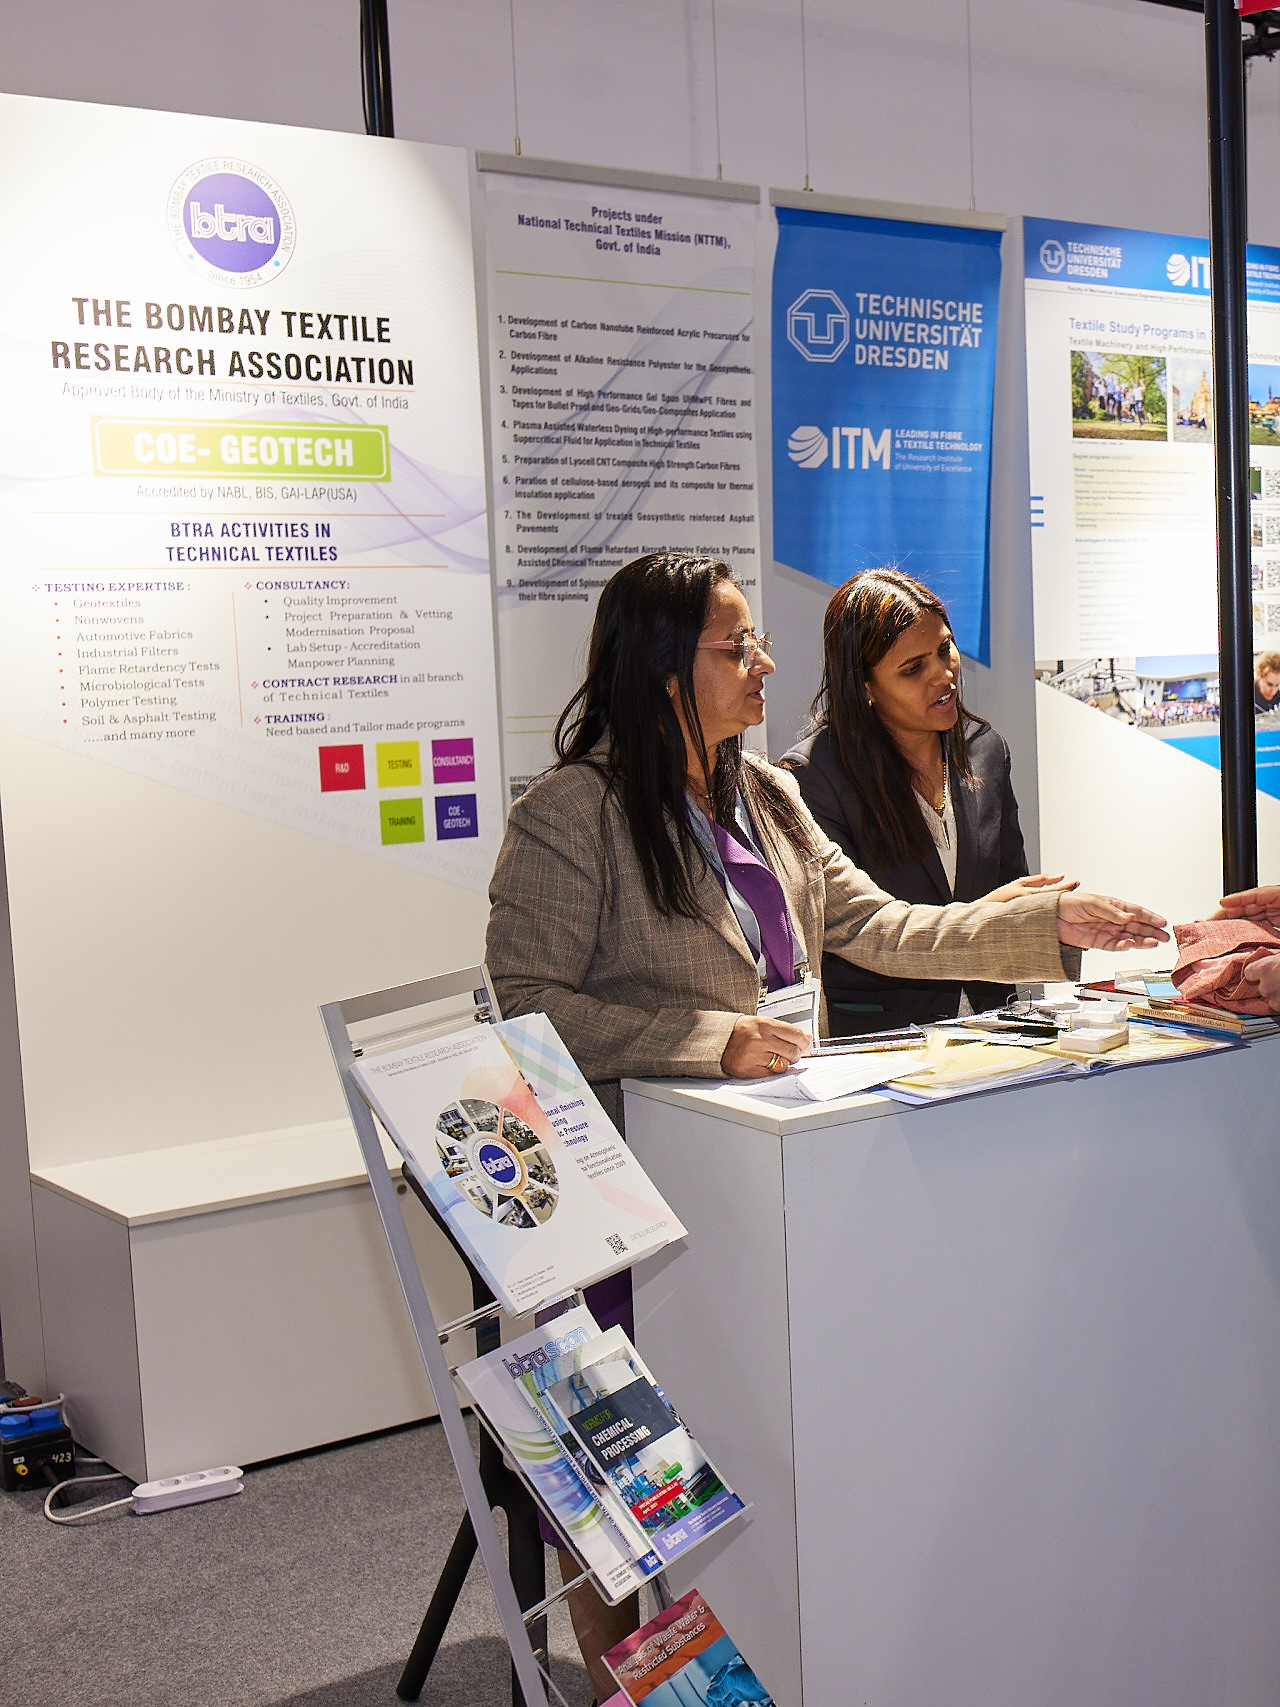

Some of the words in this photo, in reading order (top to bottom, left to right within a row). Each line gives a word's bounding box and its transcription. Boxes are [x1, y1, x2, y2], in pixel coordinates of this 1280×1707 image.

[189, 201, 275, 245] btra
[591, 206, 632, 222] Projects
[634, 213, 662, 225] under
[517, 213, 561, 230] National
[564, 219, 613, 235] Technical
[615, 224, 652, 240] Textiles
[654, 229, 691, 243] Mission
[694, 233, 731, 250] (NTTM),
[595, 238, 621, 252] Govt.
[623, 241, 634, 254] of
[636, 242, 661, 256] India
[1067, 241, 1122, 258] TECHNISCHE
[1067, 263, 1109, 279] DRESDEN
[1191, 255, 1211, 289] IT
[855, 292, 983, 324] TECHNISCHE
[72, 297, 132, 328] THE
[145, 302, 270, 336] BOMBAY
[281, 311, 391, 343] TEXTILE
[509, 329, 537, 339] Carbon
[538, 331, 558, 341] Fibre
[855, 318, 983, 348] UNIVERSITÄT
[1069, 317, 1105, 332] Textile
[1109, 321, 1141, 338] Study
[1143, 324, 1194, 340] Programs
[1196, 330, 1206, 341] in
[1069, 337, 1094, 347] Textile
[1095, 339, 1133, 351] Machinery
[1135, 342, 1149, 351] and
[1150, 343, 1167, 354] High
[51, 341, 216, 376] RESEARCH
[228, 350, 414, 385] ASSOCIATION
[854, 343, 949, 371] DRESDEN
[510, 364, 558, 375] Applications
[62, 382, 126, 402] Approved
[131, 384, 164, 403] Body
[168, 385, 182, 400] of
[184, 386, 205, 401] the
[208, 387, 259, 407] Ministry
[264, 390, 277, 405] of
[279, 391, 329, 408] Textiles,
[331, 393, 363, 409] Govt.
[366, 394, 379, 409] of
[381, 395, 409, 410] India
[220, 434, 355, 468] GEOTECH
[832, 426, 892, 470] ITM
[895, 429, 929, 439] LEADING
[930, 430, 939, 440] IN
[940, 431, 963, 441] FIBRE
[903, 440, 935, 450] TEXTILE
[936, 442, 983, 452] TECHNOLOGY
[136, 484, 198, 499] Accredited
[200, 486, 214, 502] by
[217, 486, 253, 501] NABL,
[255, 487, 279, 502] BIS,
[170, 522, 214, 538] BTRA
[220, 522, 311, 539] ACTIVITIES
[315, 522, 332, 539] IN
[516, 523, 559, 533] Pavements
[166, 546, 260, 562] TECHNICAL
[265, 545, 338, 562] TEXTILES
[44, 582, 105, 593] TESTING
[108, 581, 185, 592] EXPERTISE
[256, 580, 350, 591] CONSULTANCY:
[73, 598, 141, 609] Geotextiles
[283, 595, 324, 607] Quality
[326, 595, 397, 607] Improvement
[74, 615, 144, 625] Nonwovens
[284, 612, 323, 624] Project
[329, 610, 393, 622] Preparation
[399, 610, 409, 620] &
[414, 609, 453, 621] Vetting
[76, 632, 146, 642] Automotive
[149, 630, 193, 641] Fabrics
[285, 626, 365, 638] Modernisation
[369, 624, 415, 637] Proposal
[77, 647, 138, 659] Industrial
[141, 646, 179, 657] Filters
[286, 643, 308, 653] Lab
[309, 642, 342, 654] Setup
[349, 640, 421, 652] Accreditation
[78, 664, 116, 675] Flame
[119, 662, 187, 675] Retardency
[188, 661, 220, 672] Tests
[287, 657, 344, 669] Manpower
[346, 655, 395, 668] Planning
[79, 678, 171, 692] Microbiological
[173, 677, 205, 689] Tests
[262, 677, 330, 689] CONTRACT
[332, 674, 398, 686] RESEARCH
[400, 675, 410, 684] in
[412, 674, 426, 683] all
[427, 672, 464, 682] branch
[80, 697, 130, 710] Polymer
[132, 694, 177, 707] Testing
[262, 692, 274, 703] of
[278, 690, 343, 702] Technical
[347, 688, 389, 700] Textiles
[81, 713, 105, 726] Soil
[109, 714, 120, 725] &
[122, 711, 169, 726] Asphalt
[172, 710, 217, 722] Testing
[264, 712, 325, 724] TRAINING
[129, 731, 162, 742] many
[165, 729, 196, 739] more
[265, 726, 294, 738] Need
[296, 724, 328, 736] based
[330, 723, 351, 734] and
[353, 721, 384, 733] Tailor
[385, 720, 415, 731] made
[416, 718, 466, 731] programs
[387, 759, 413, 770] TESTING
[432, 755, 475, 767] CONSULTANCY
[387, 816, 416, 828] TRAINING
[442, 817, 471, 830] GEOTECH
[563, 1121, 590, 1136] Pressure
[481, 1155, 513, 1175] btra
[591, 1417, 634, 1447] CHEMICAL
[600, 1425, 652, 1461] PROCESSING
[51, 1452, 72, 1464] 423
[654, 1626, 678, 1646] Waste
[676, 1610, 698, 1630] Water
[631, 1650, 668, 1681] Restricted
[665, 1622, 707, 1655] Substances
